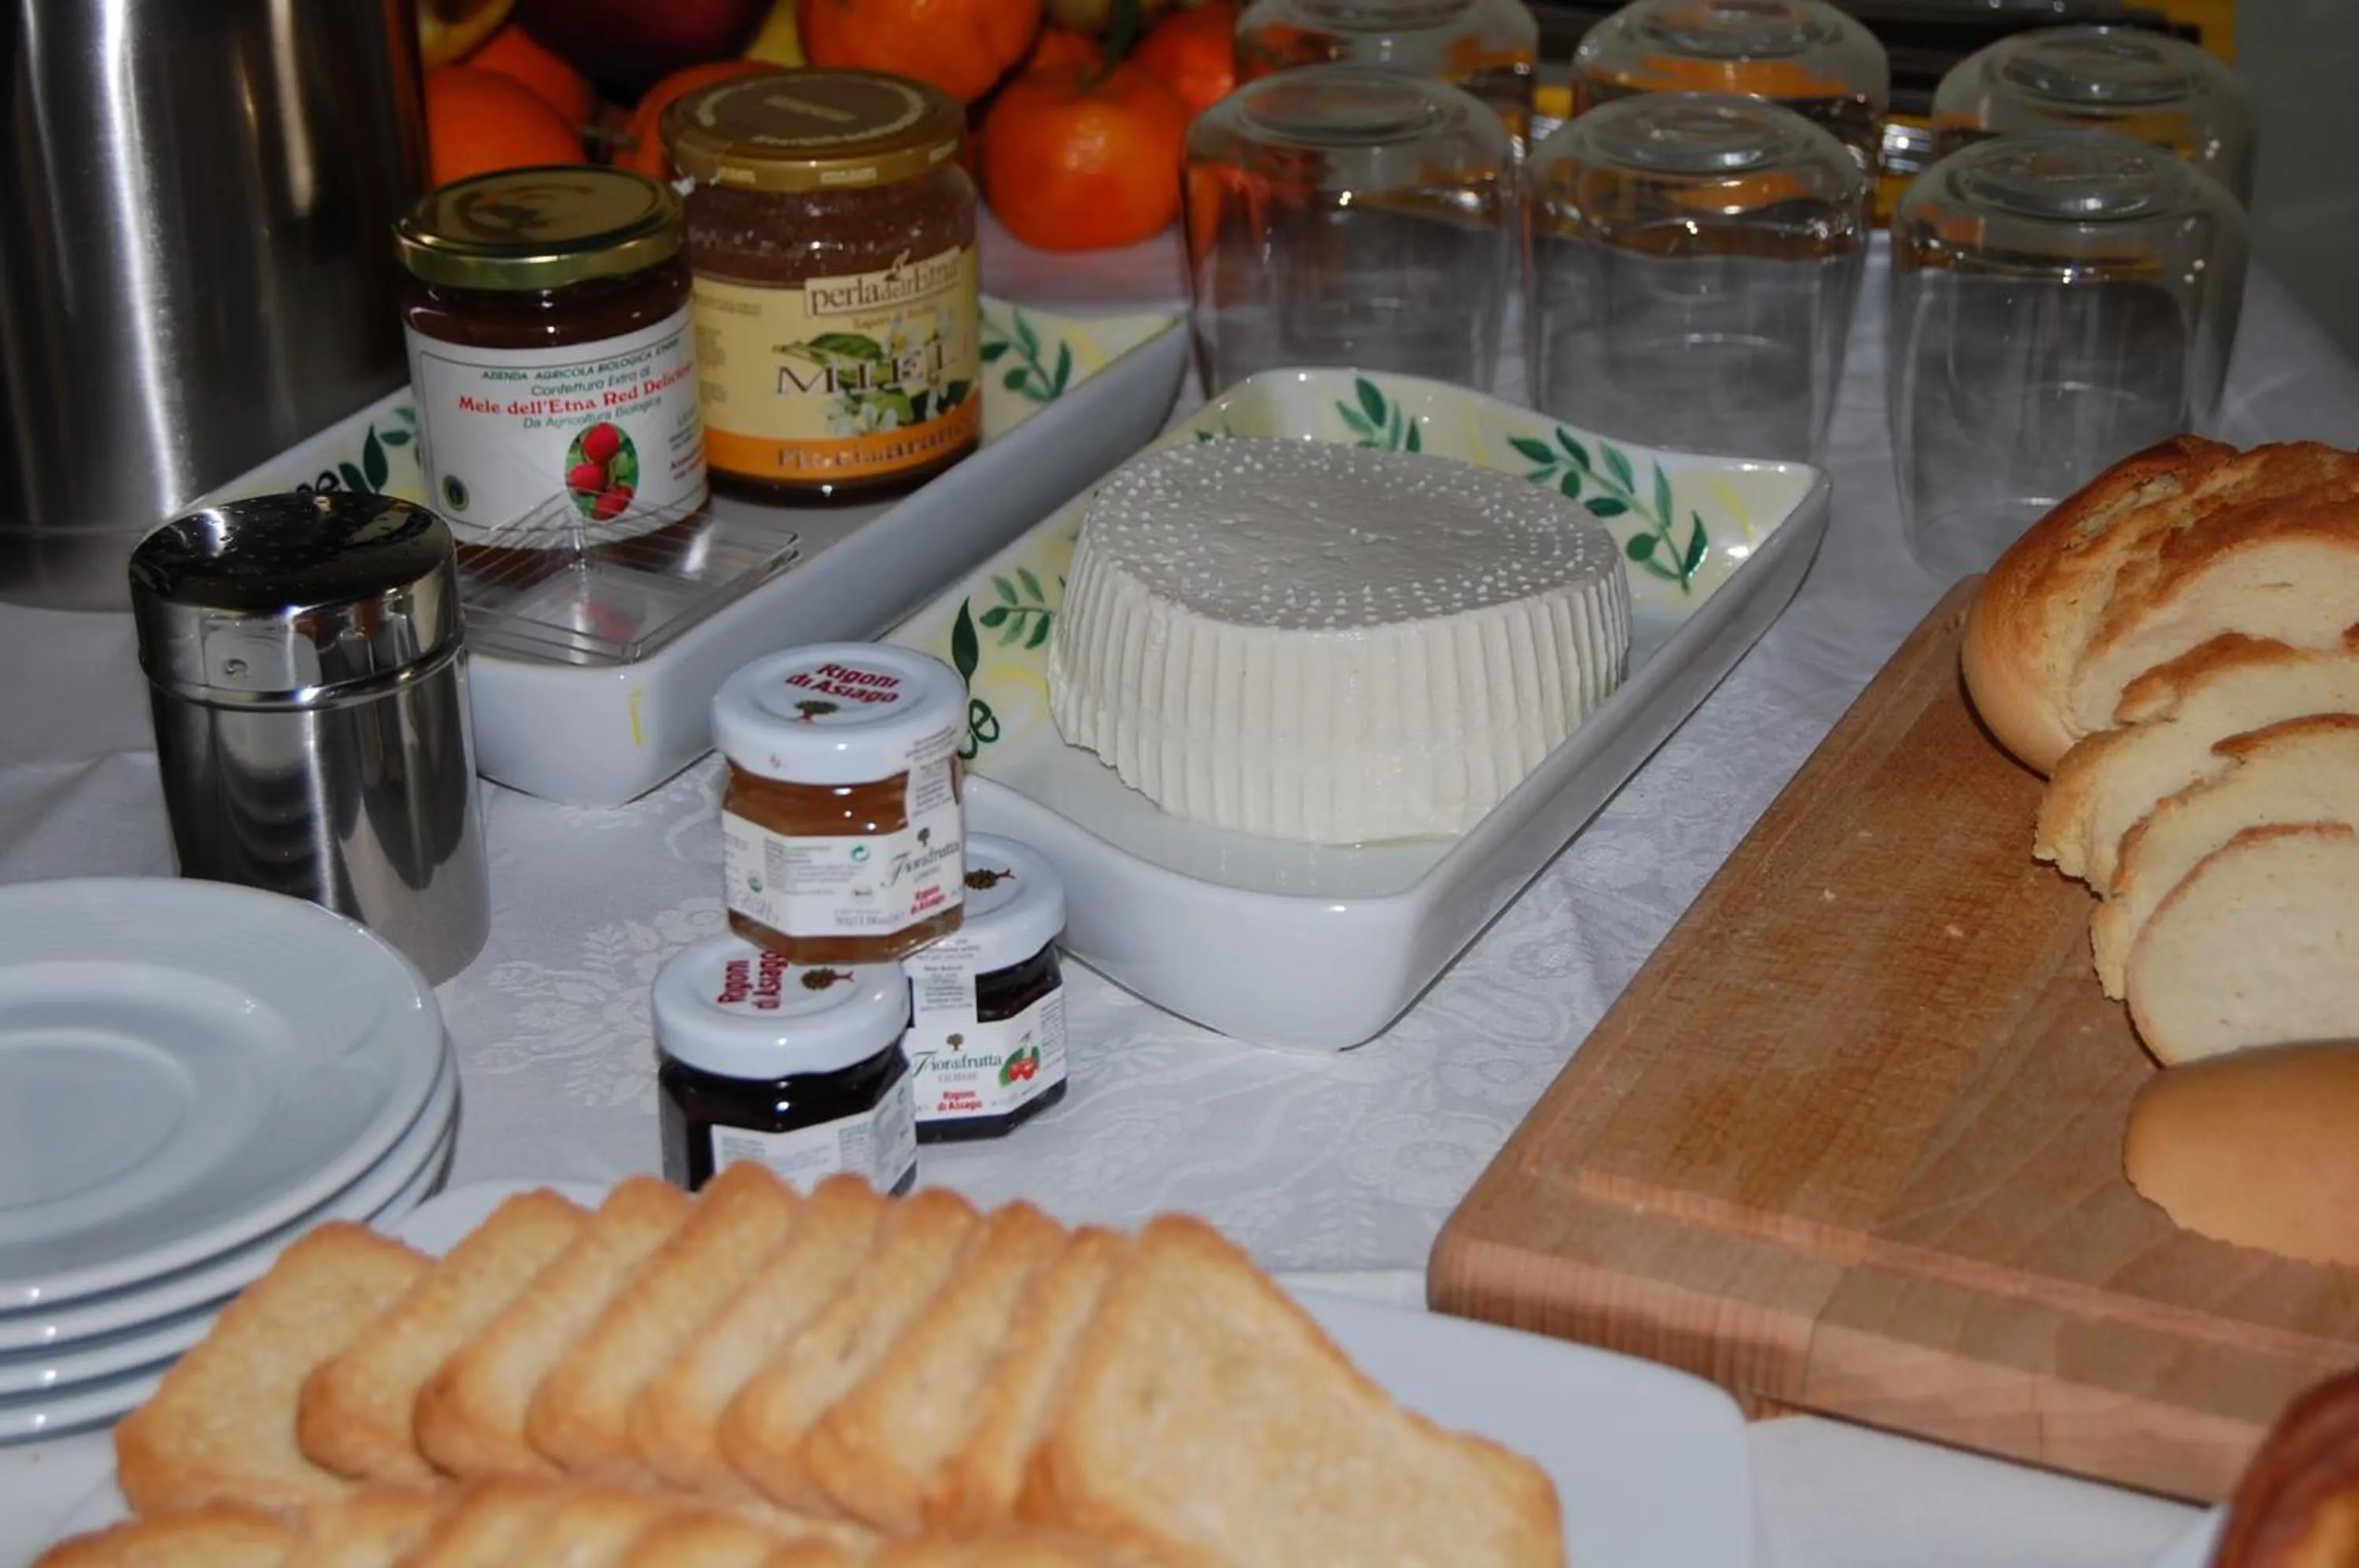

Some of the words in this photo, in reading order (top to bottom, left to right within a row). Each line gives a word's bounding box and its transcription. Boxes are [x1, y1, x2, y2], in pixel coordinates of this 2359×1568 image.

[810, 277, 879, 315] perla
[534, 365, 594, 380] AGRICOLA
[458, 395, 501, 414] Mele
[506, 399, 597, 414] dell'Etna
[603, 385, 639, 407] Red
[523, 417, 541, 429] Da
[785, 673, 813, 688] di
[809, 679, 900, 703] Asiago
[815, 663, 901, 688] Rigoni
[717, 960, 753, 1003] Rigoni
[753, 951, 788, 996] Asiago
